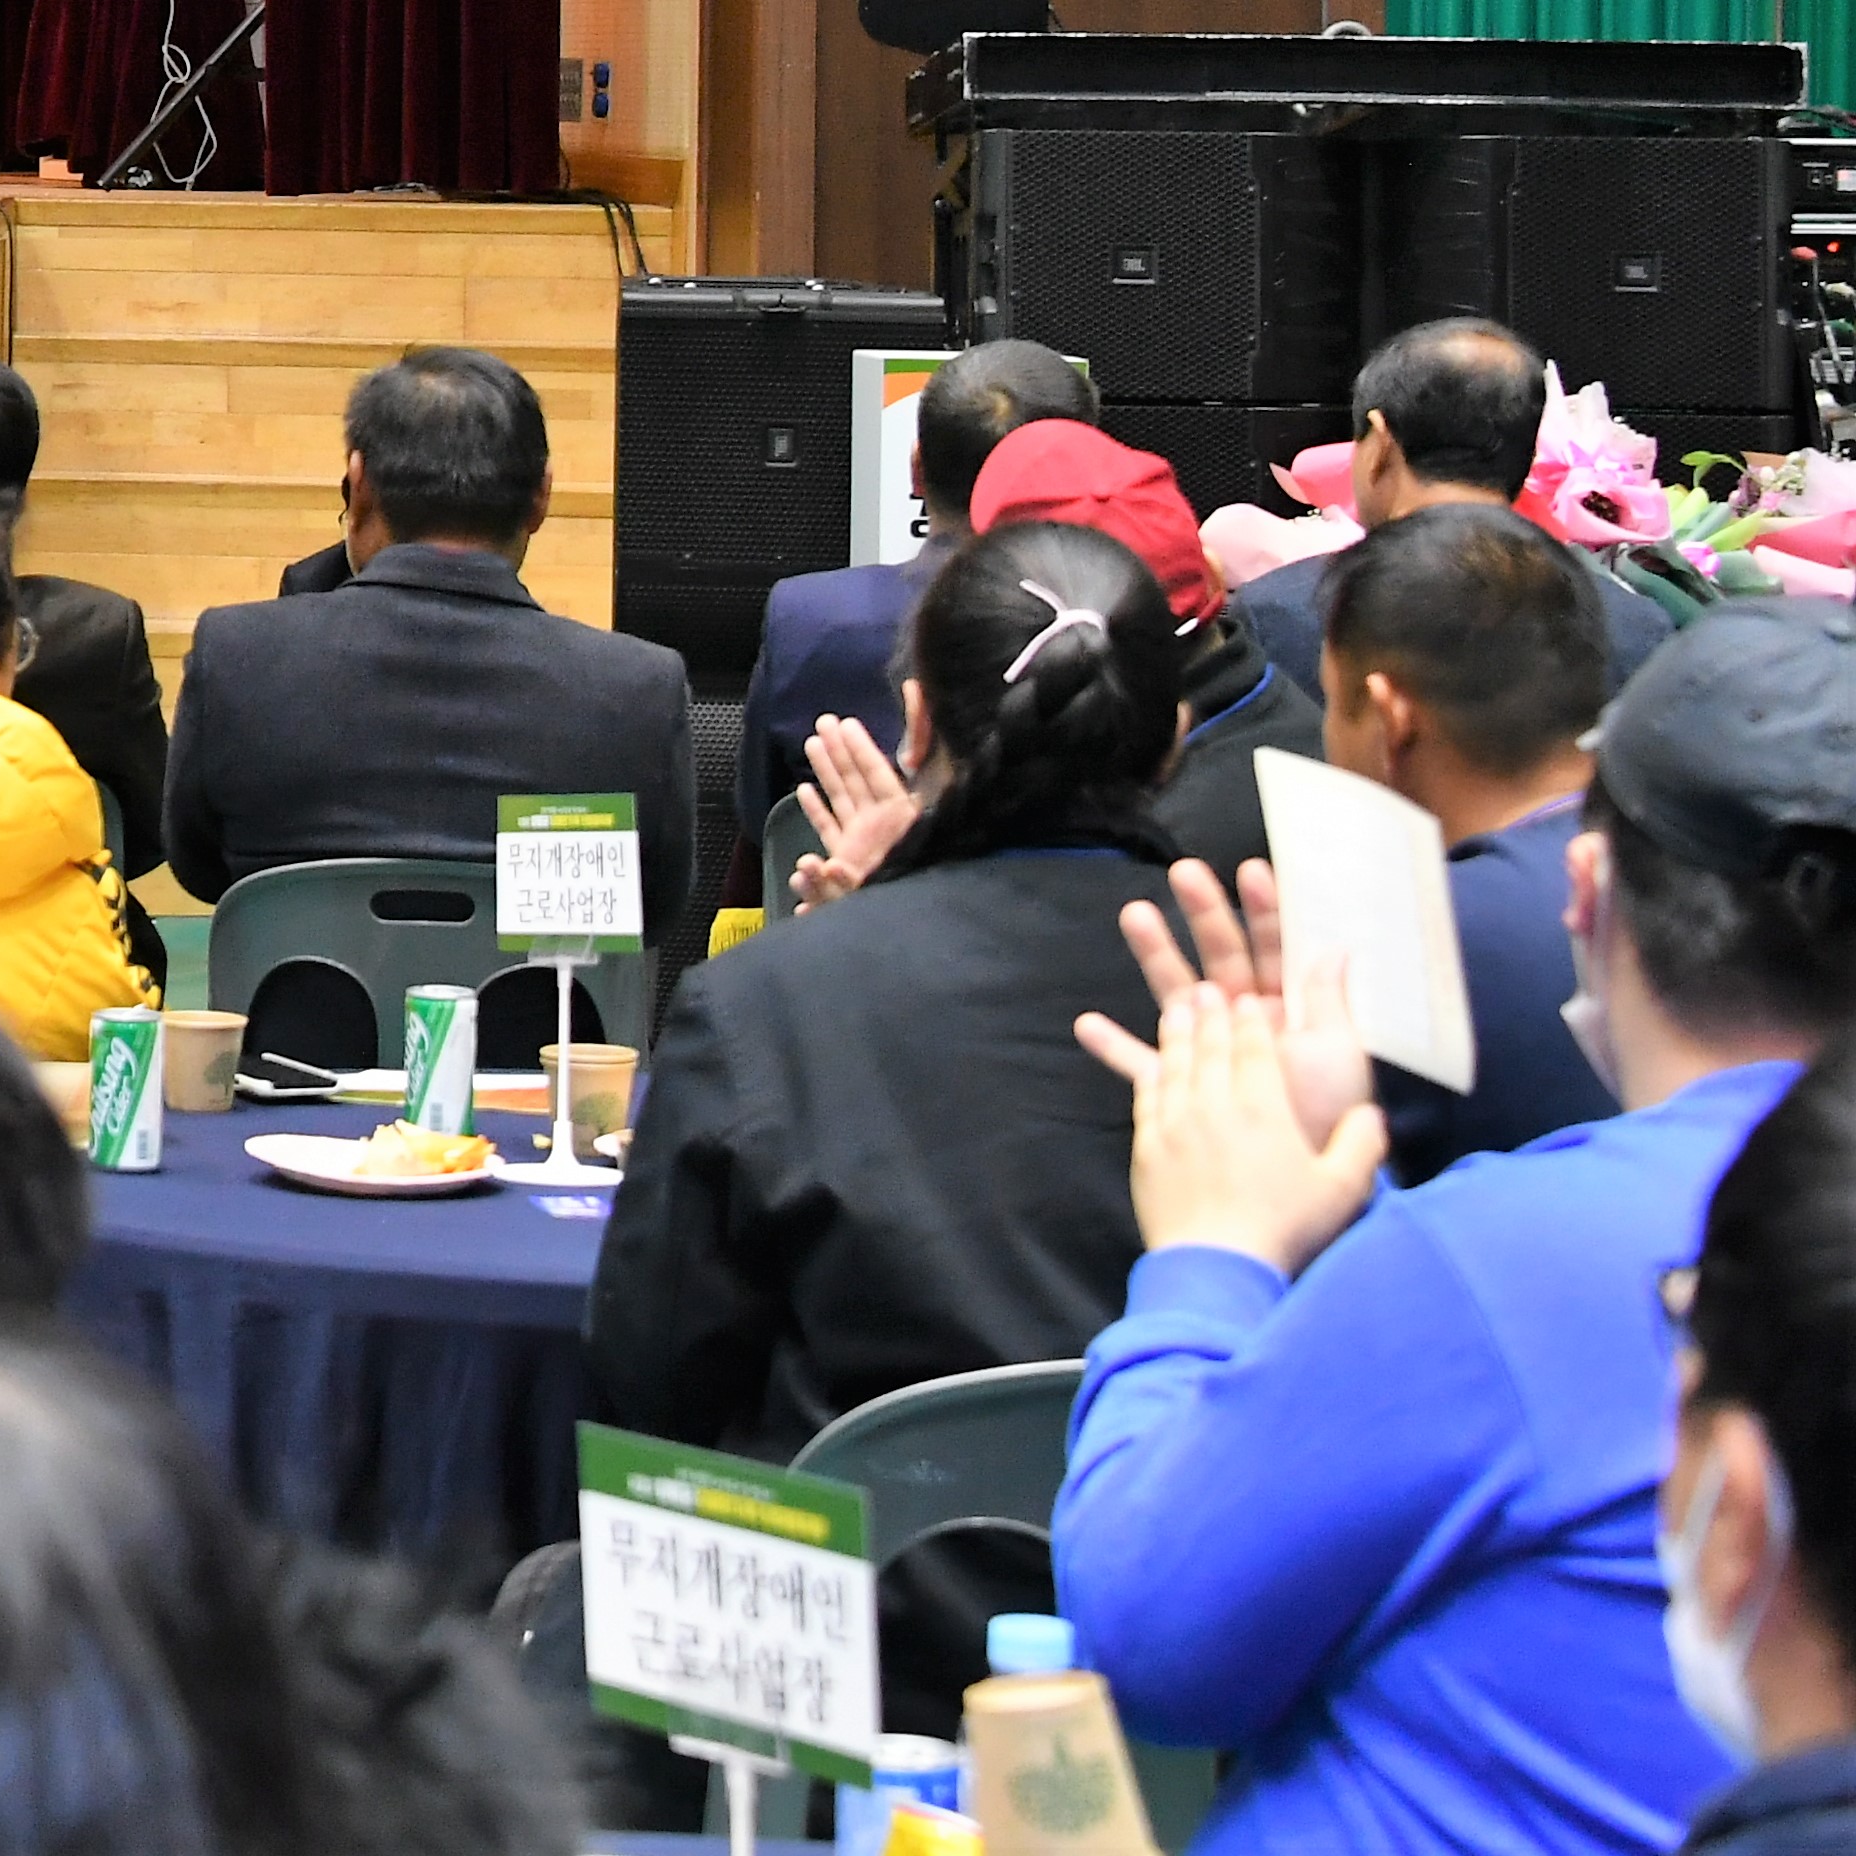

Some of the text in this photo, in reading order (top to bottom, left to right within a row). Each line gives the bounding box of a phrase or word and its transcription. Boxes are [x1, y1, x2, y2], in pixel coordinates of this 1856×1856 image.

[507, 841, 625, 879] 무지개장애인
[516, 887, 617, 925] 근로사업장
[609, 1517, 848, 1642] 무지개장애인
[632, 1608, 834, 1723] 근로사업장
